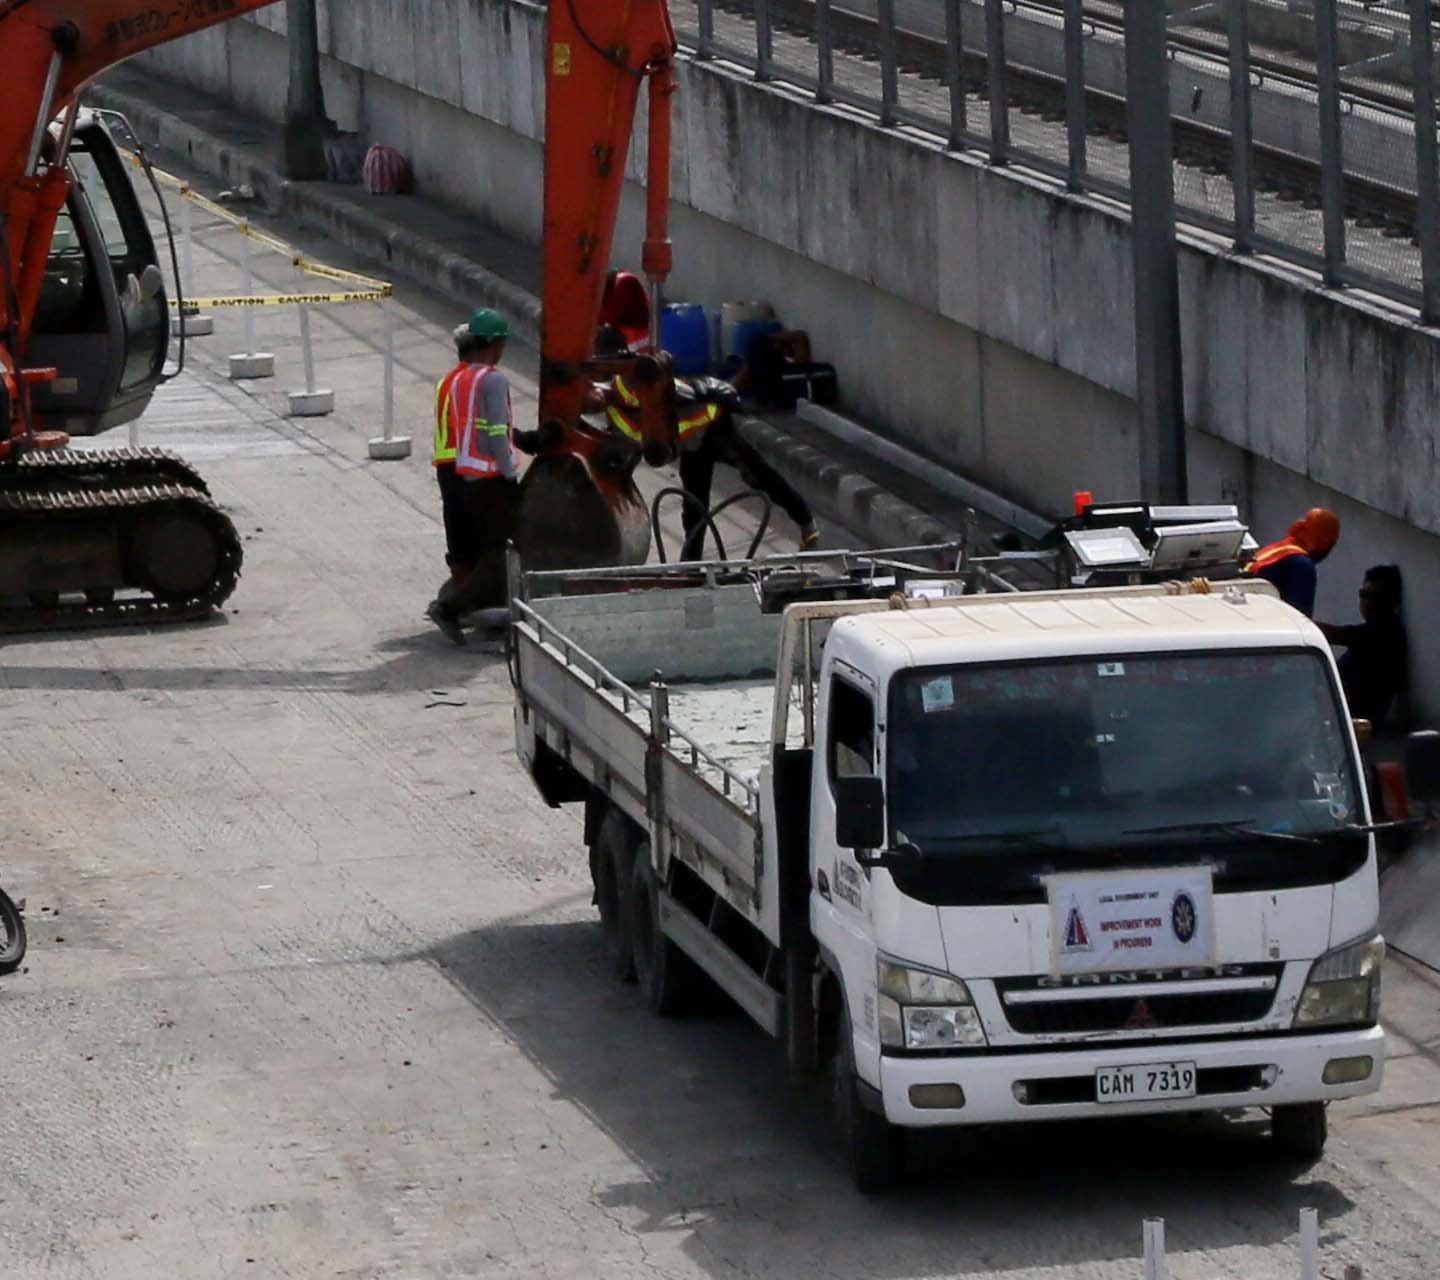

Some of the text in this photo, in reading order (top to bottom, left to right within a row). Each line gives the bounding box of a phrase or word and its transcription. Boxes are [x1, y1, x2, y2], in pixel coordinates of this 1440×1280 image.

[212, 298, 264, 307] CAUTION
[278, 296, 330, 304] CAUTION
[1100, 918, 1143, 931] IMPROVEMENT
[1100, 1070, 1194, 1094] CAM 7319
